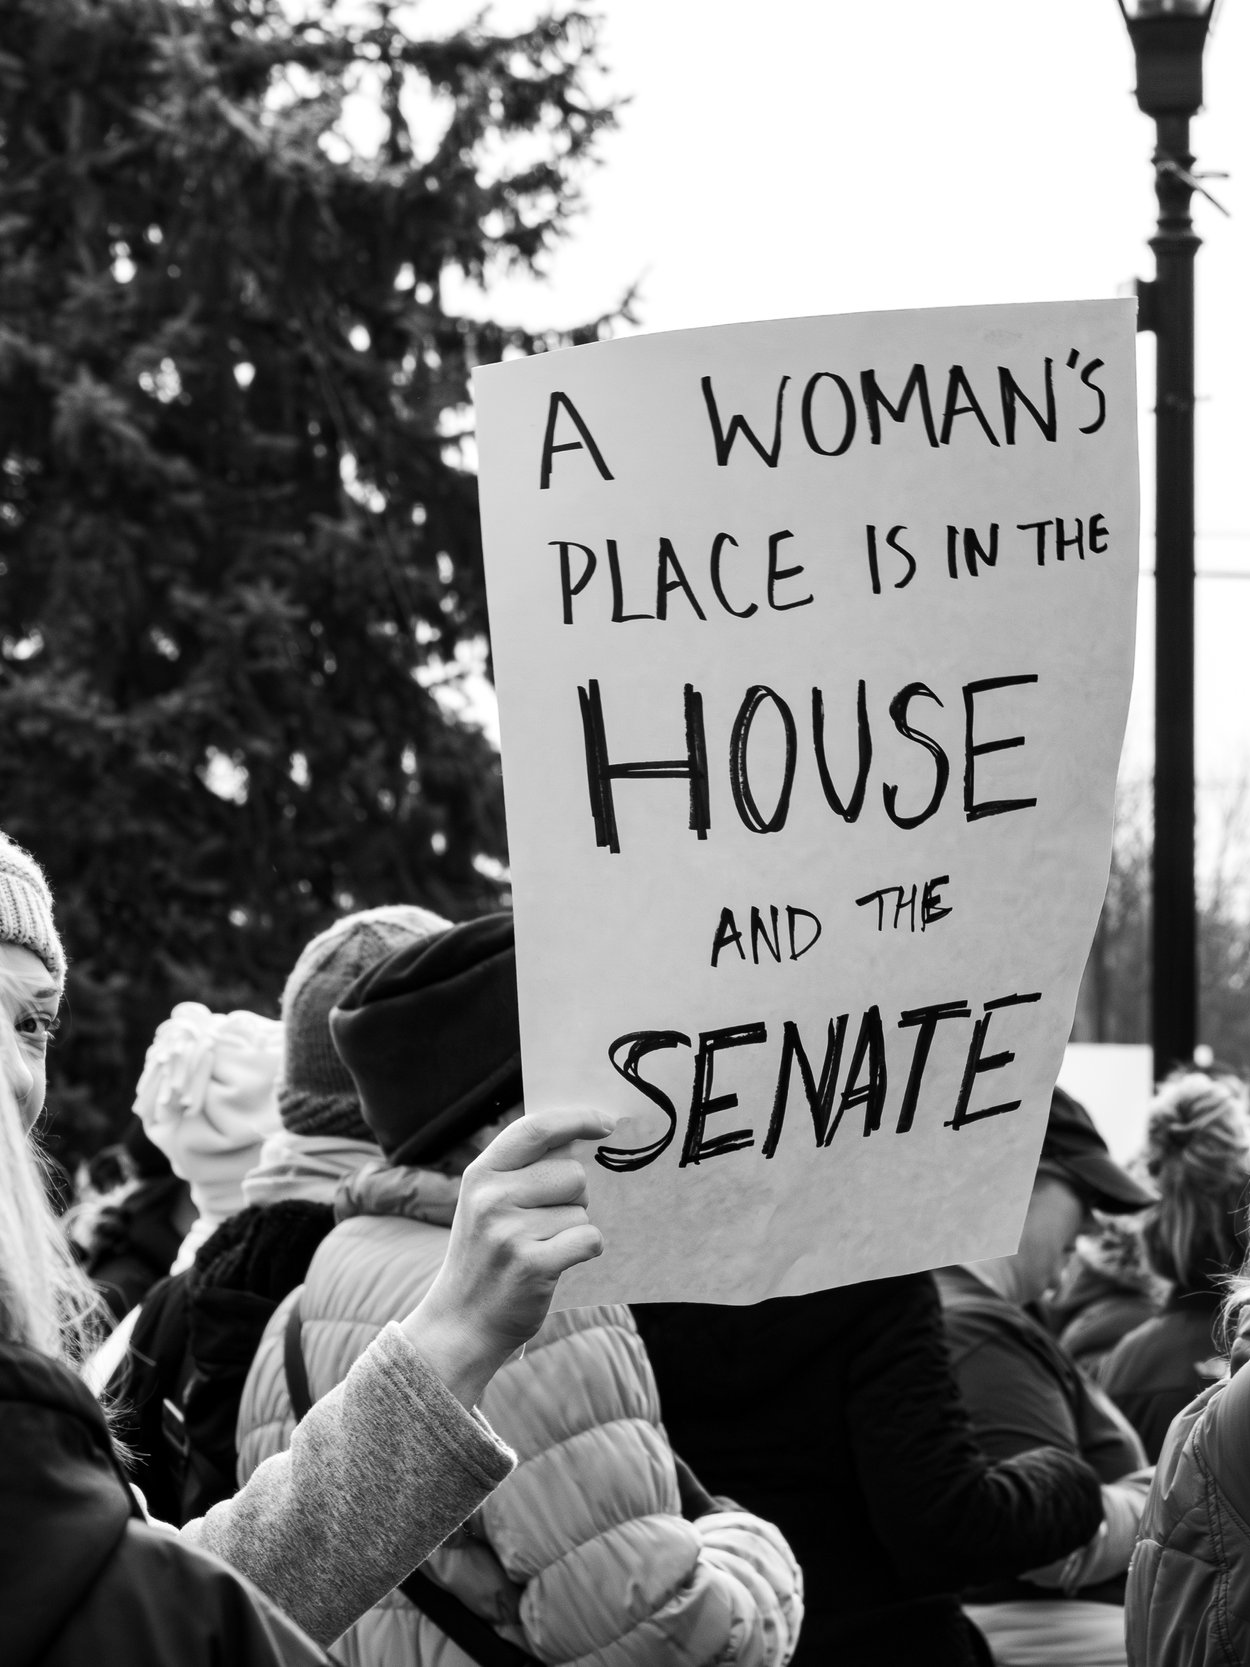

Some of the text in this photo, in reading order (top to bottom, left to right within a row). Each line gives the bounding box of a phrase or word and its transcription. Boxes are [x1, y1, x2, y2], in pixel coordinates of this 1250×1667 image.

[540, 348, 1106, 489] A WOMAN'S
[548, 513, 1110, 625] PLACE IS IN THE
[577, 674, 1039, 854] HOUSE
[710, 875, 953, 967] AND THE
[594, 993, 1043, 1173] SENATE
